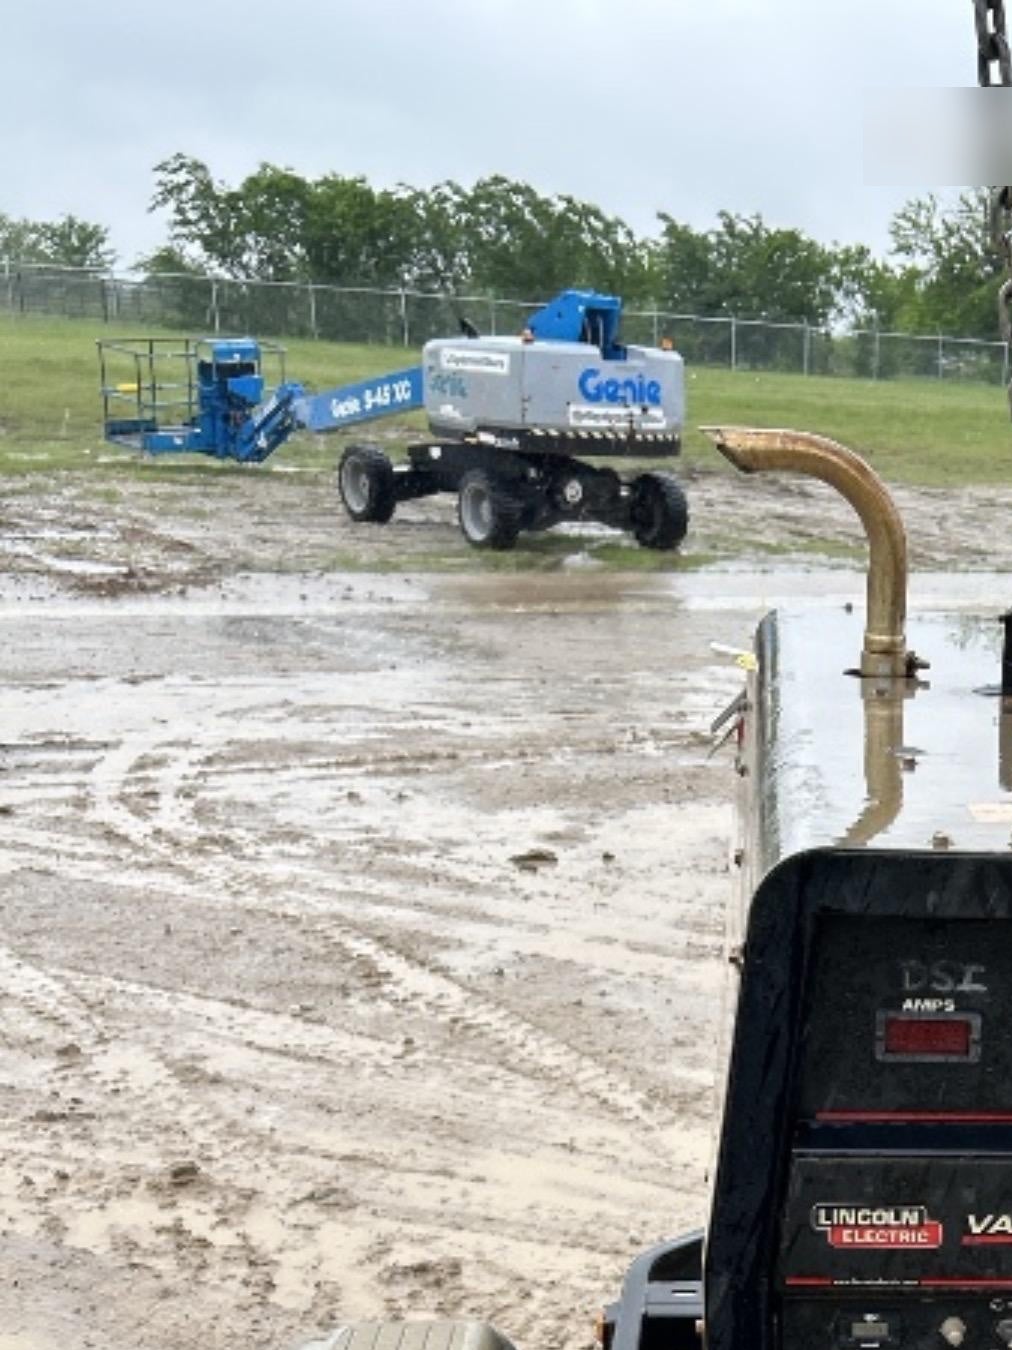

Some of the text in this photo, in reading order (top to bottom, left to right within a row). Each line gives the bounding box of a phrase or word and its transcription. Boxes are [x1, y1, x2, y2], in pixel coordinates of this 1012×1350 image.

[578, 368, 662, 404] Genie
[902, 998, 956, 1012] AMPS
[817, 1209, 919, 1226] LINCOLN
[842, 1228, 930, 1243] ELECTRIC
